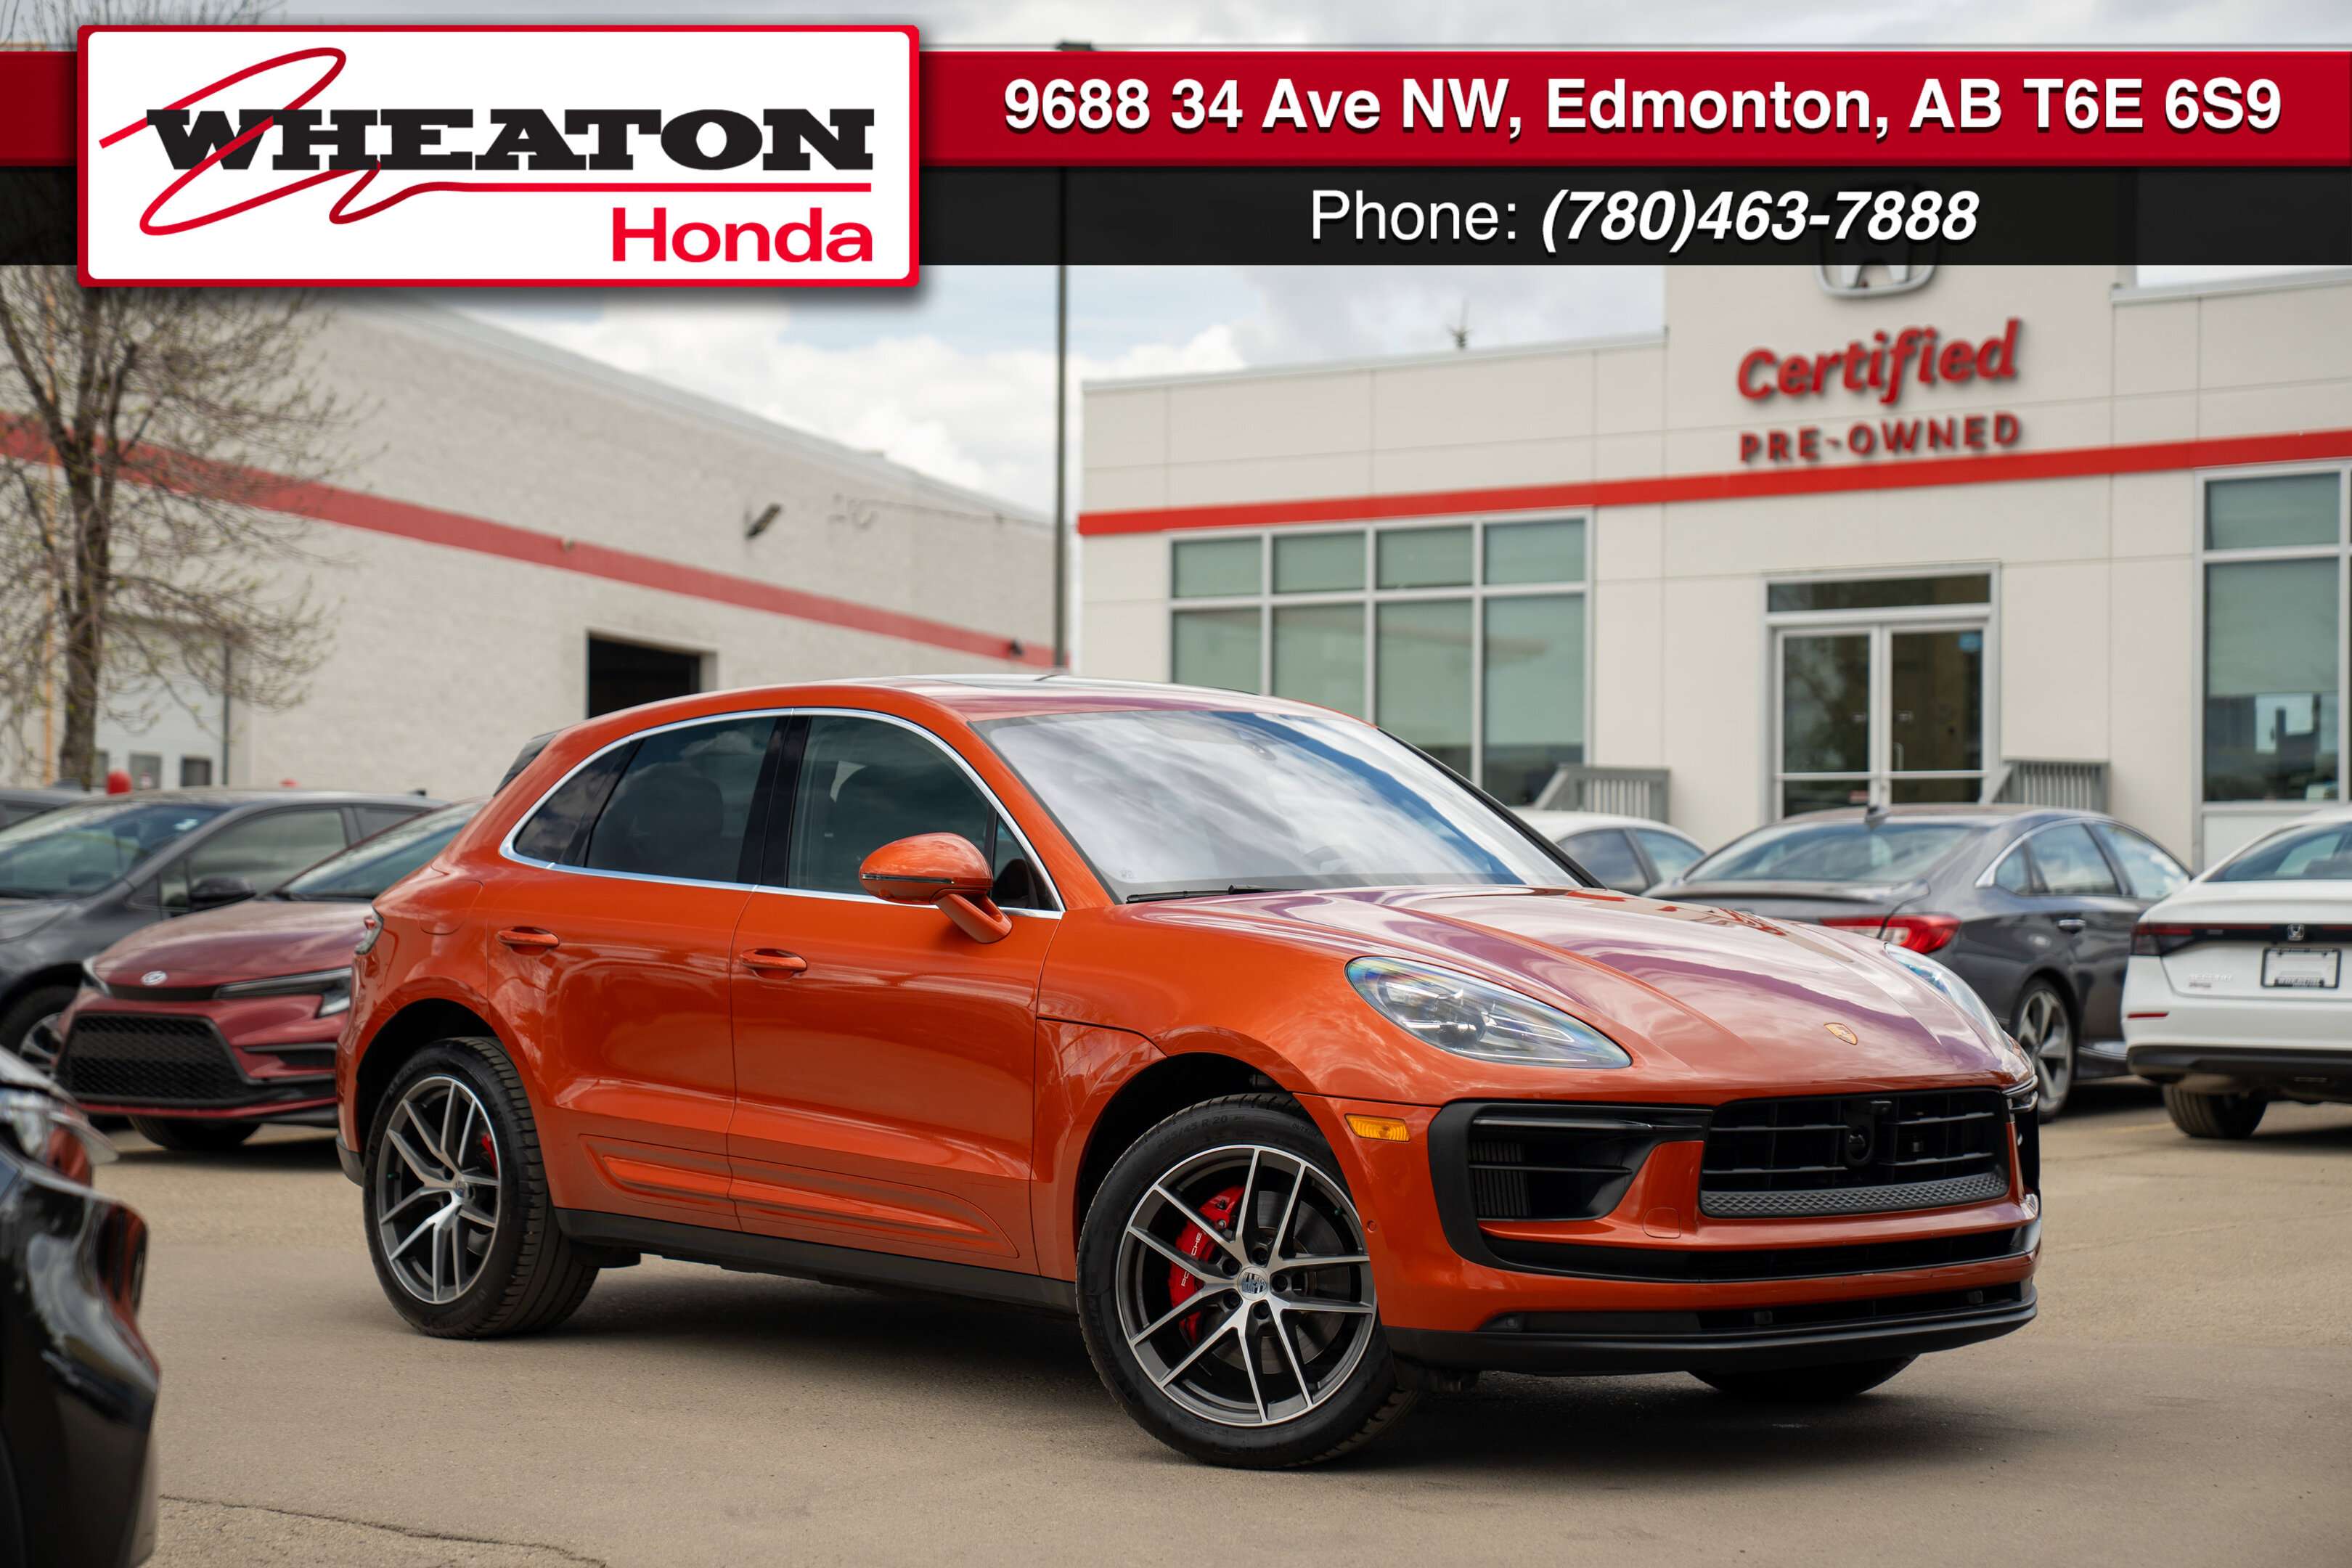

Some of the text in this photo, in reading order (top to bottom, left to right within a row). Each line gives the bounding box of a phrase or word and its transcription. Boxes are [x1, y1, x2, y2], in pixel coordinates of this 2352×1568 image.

[1736, 317, 2021, 404] Certified
[1740, 412, 2020, 462] PRE-OWNED
[1180, 1232, 1203, 1287] POCHE
